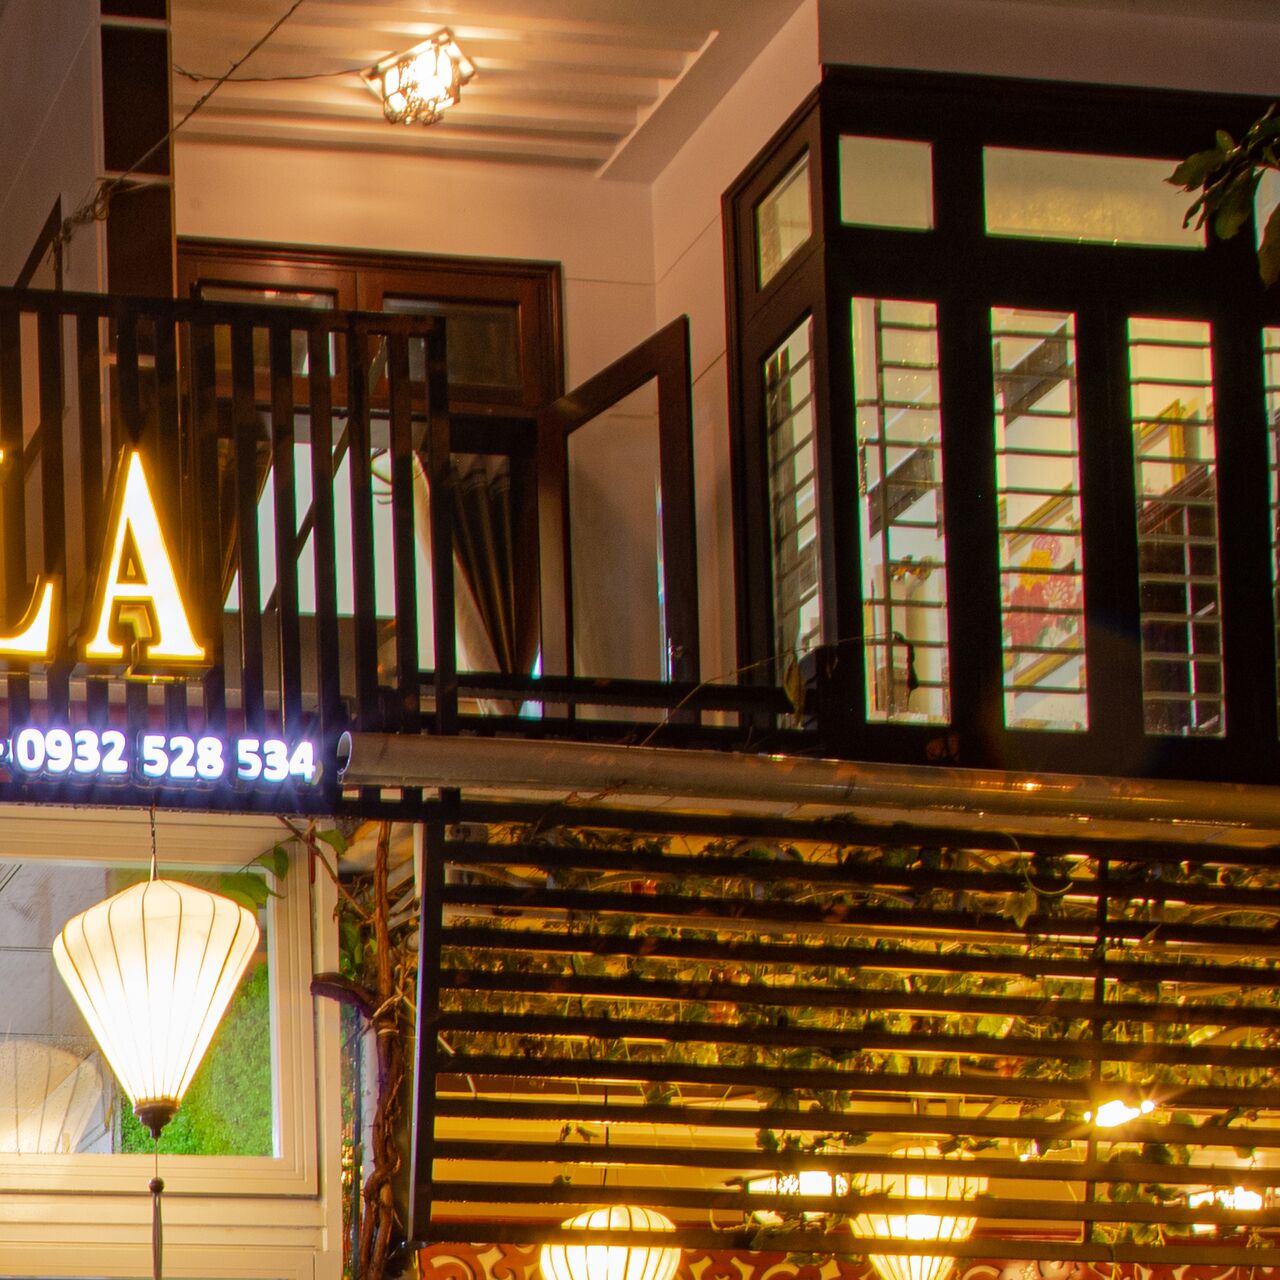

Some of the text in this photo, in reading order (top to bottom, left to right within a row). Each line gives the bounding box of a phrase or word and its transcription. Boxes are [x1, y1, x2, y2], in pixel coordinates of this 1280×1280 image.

[17, 728, 128, 773] 0932
[143, 734, 224, 778] 528
[238, 738, 315, 781] 534
